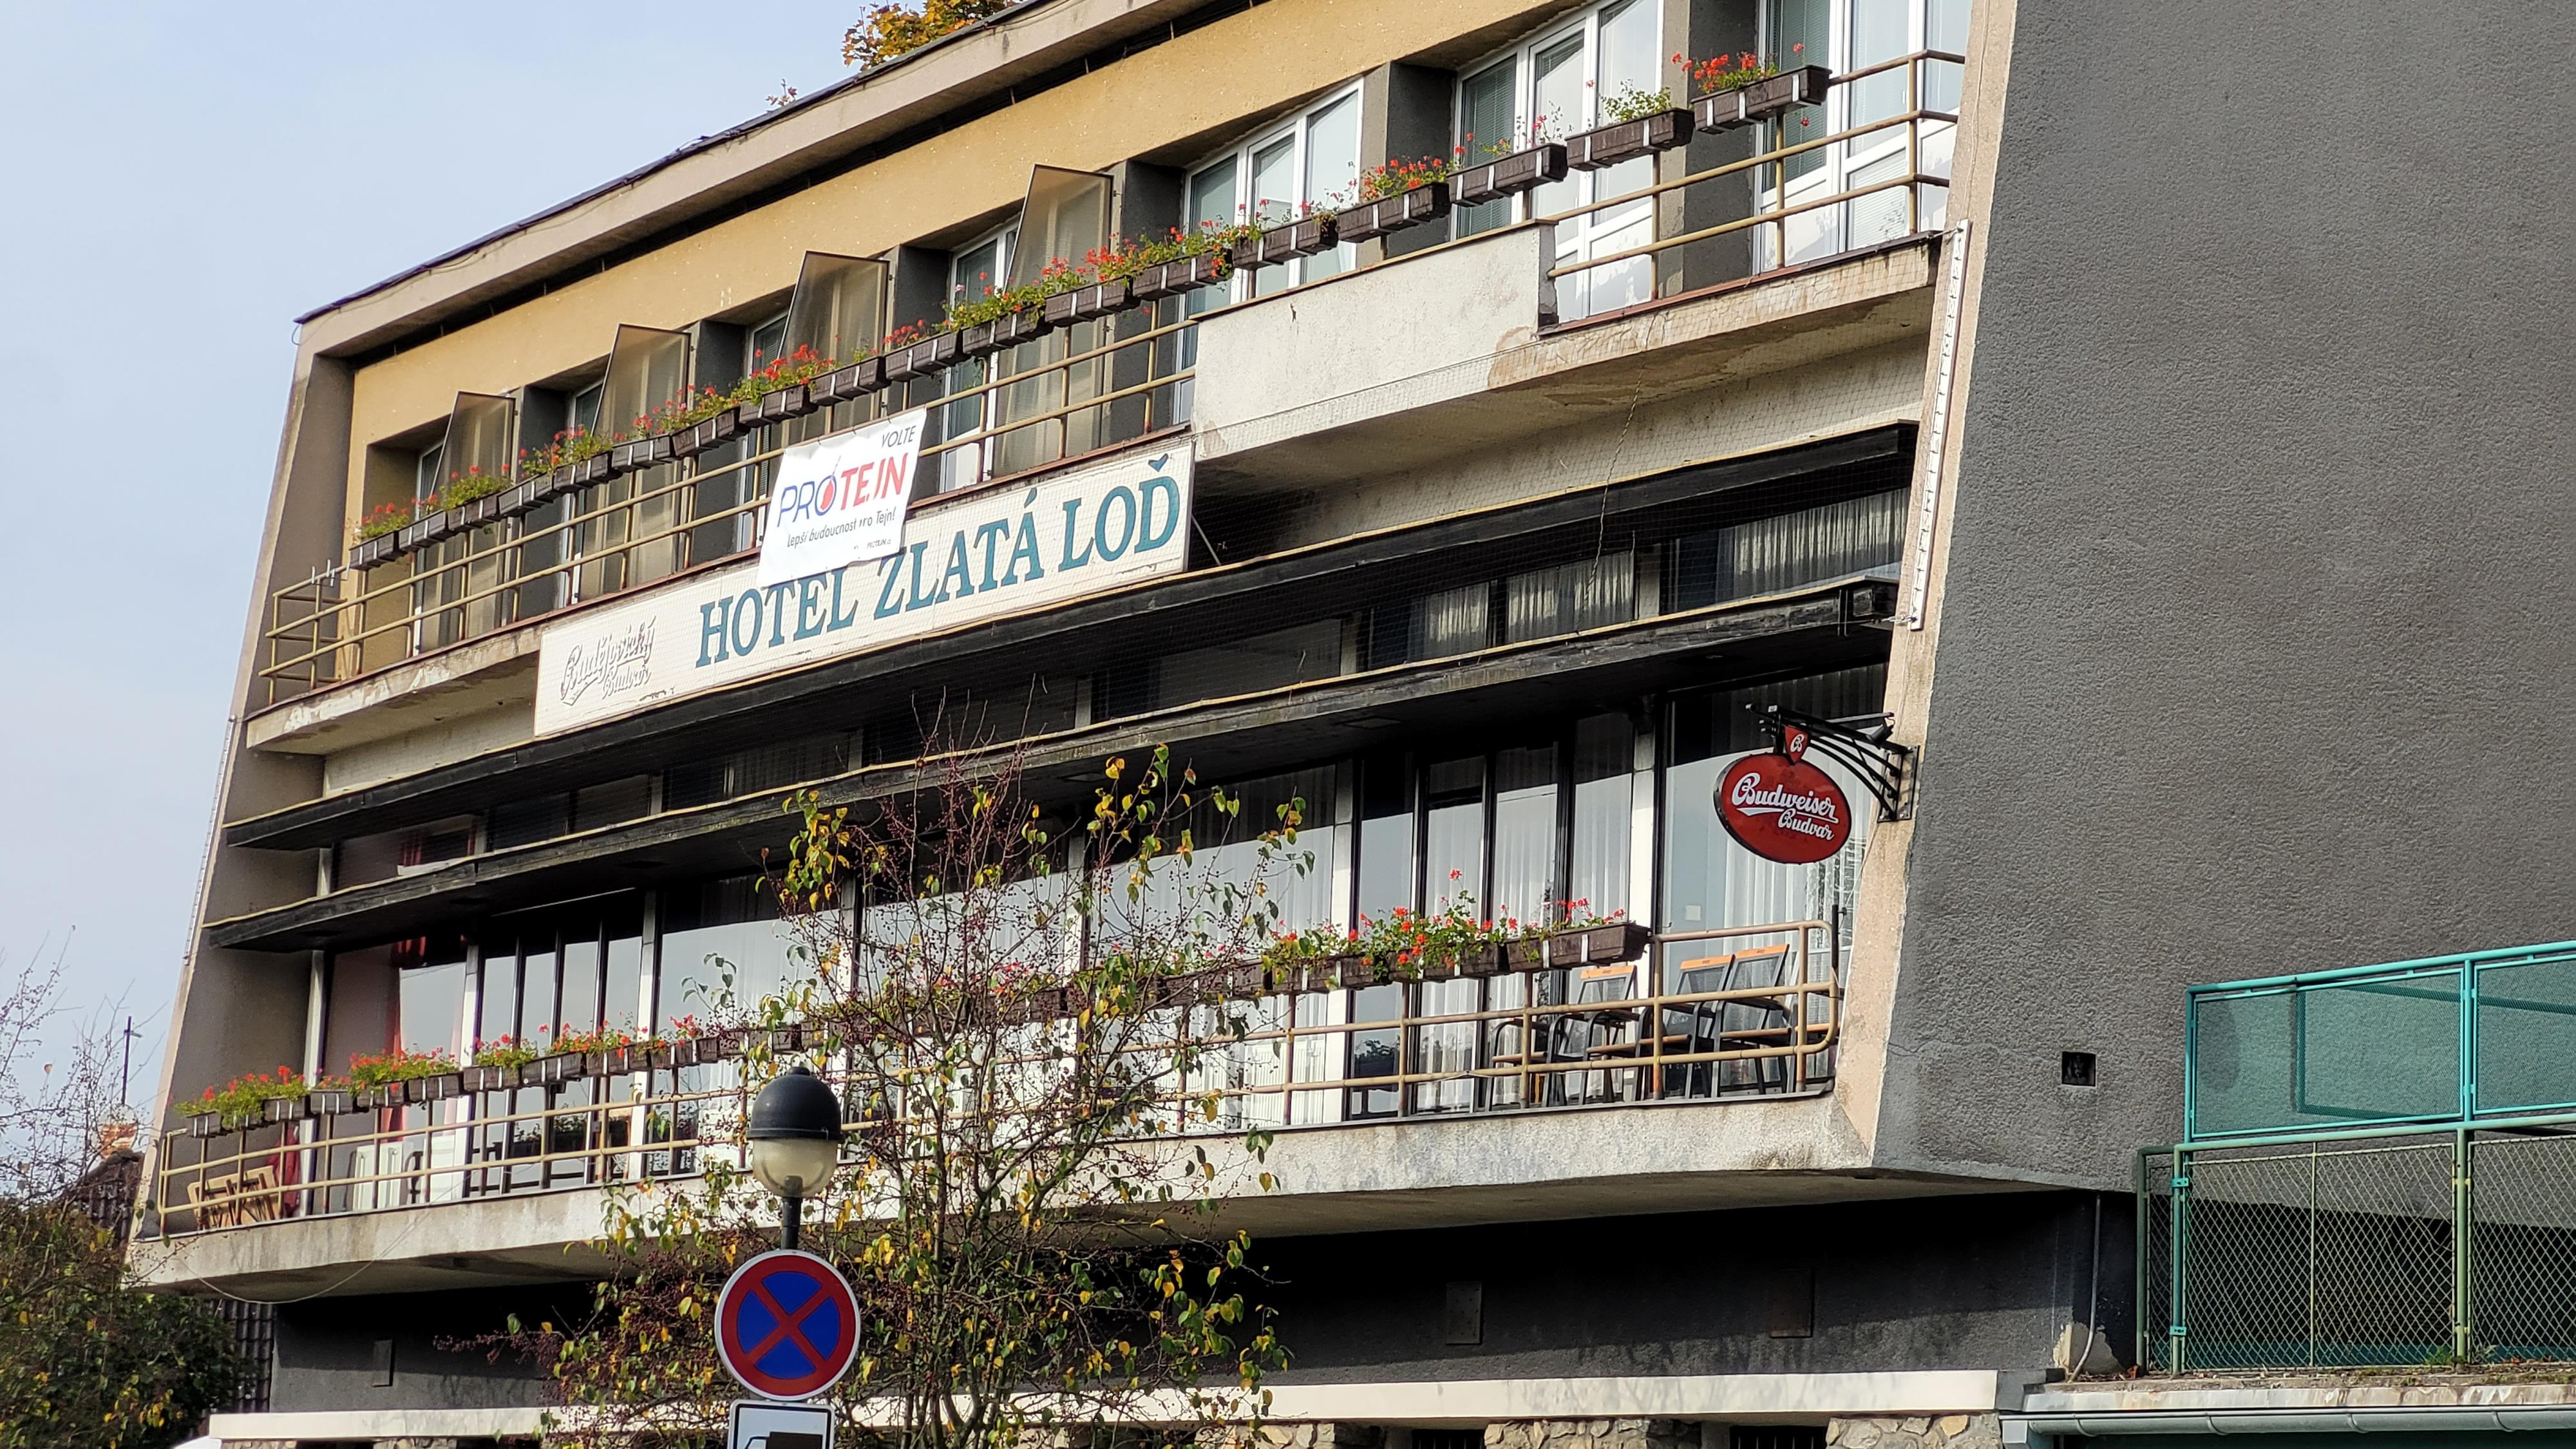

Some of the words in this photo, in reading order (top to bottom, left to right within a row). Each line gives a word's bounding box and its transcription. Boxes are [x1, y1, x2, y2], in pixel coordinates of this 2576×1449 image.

[881, 425, 916, 448] VOLTE
[809, 517, 857, 542] budoucnost
[876, 506, 896, 526] Tejn!
[696, 565, 858, 668] HOTEL
[874, 488, 1044, 620] ZLATÁ
[1058, 453, 1180, 572] LOĎ
[1790, 734, 1804, 753] B
[1731, 772, 1837, 819] Budweiser
[1777, 809, 1835, 841] Budvar
